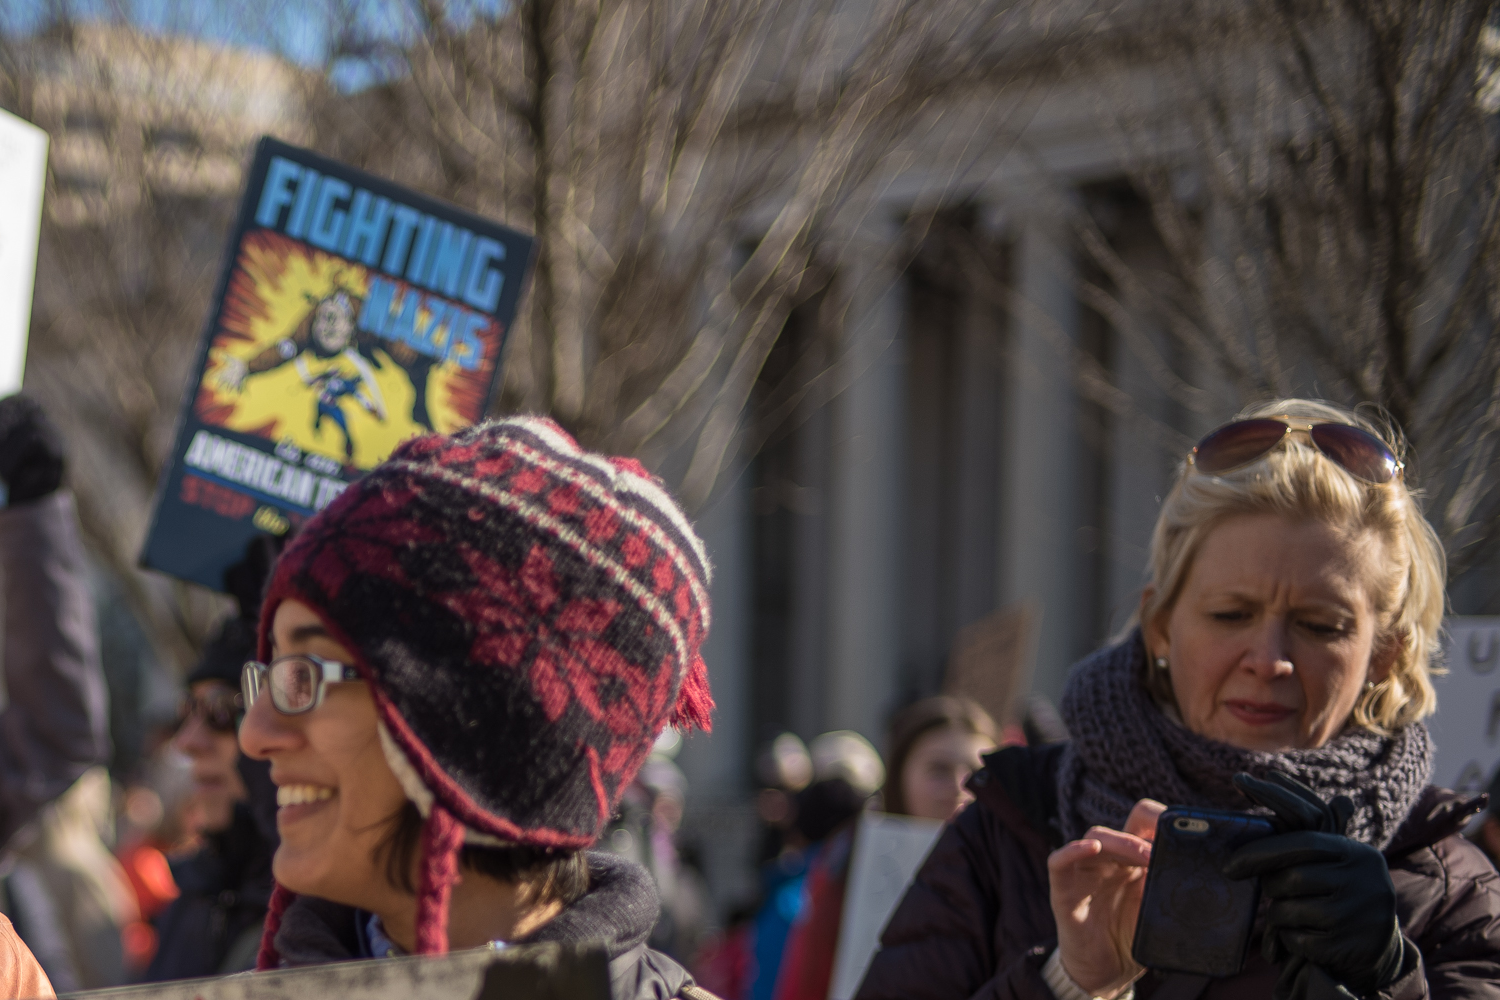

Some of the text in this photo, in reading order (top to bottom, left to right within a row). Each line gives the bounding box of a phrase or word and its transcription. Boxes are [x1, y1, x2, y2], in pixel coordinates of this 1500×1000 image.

[254, 155, 506, 313] FIGHTING
[358, 275, 492, 371] NAZIS
[184, 429, 316, 509] AMERICAN
